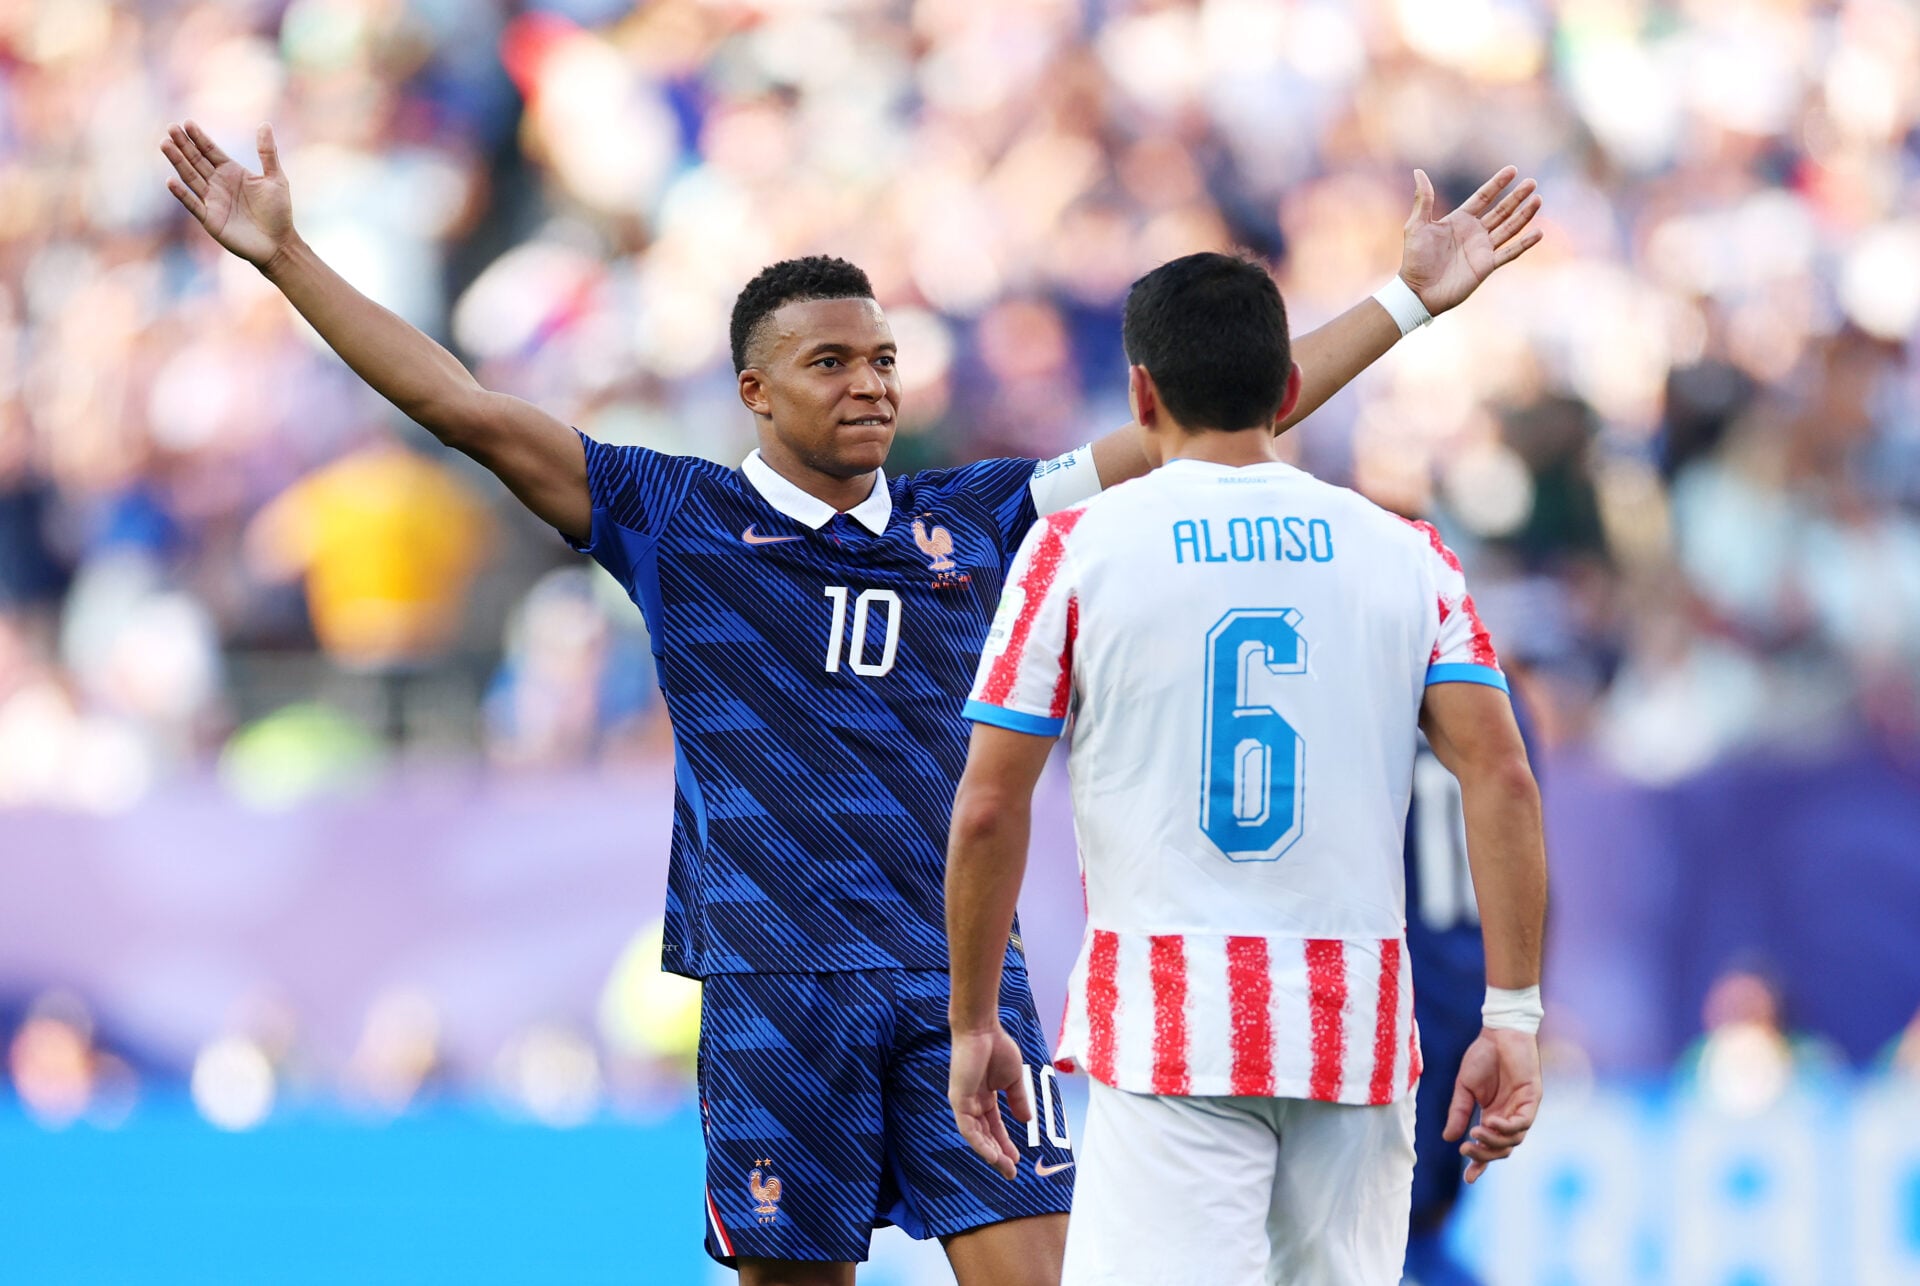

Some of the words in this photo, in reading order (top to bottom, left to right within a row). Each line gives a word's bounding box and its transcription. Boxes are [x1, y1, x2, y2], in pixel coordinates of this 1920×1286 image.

[1173, 516, 1334, 564] ALONSO
[824, 585, 902, 677] 10
[1199, 607, 1308, 862] 6
[1022, 1063, 1071, 1149] 10
[759, 1216, 776, 1224] FFF
